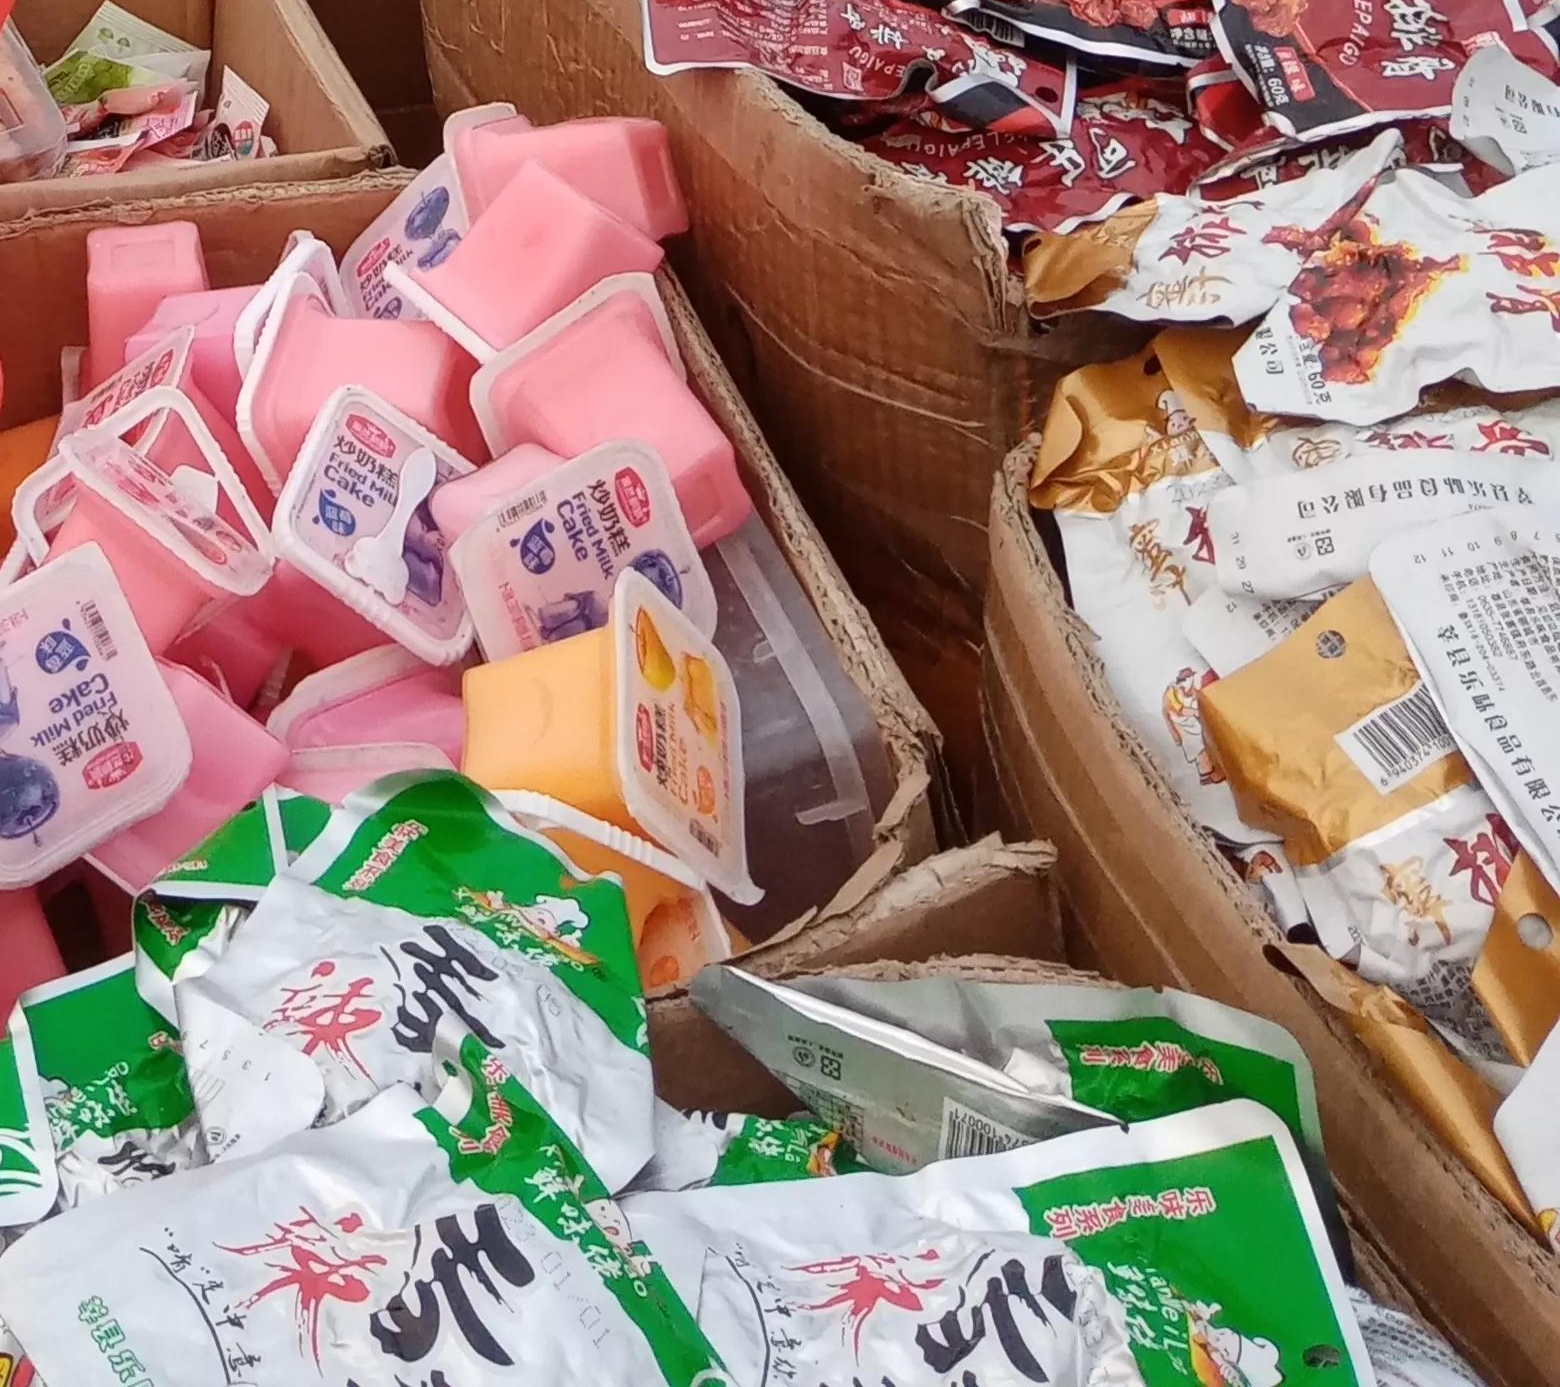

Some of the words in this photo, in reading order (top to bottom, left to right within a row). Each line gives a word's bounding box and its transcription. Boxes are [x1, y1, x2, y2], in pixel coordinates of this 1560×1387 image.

[322, 469, 376, 511] Cake
[587, 476, 632, 555] 炒奶糕
[554, 498, 589, 563] Cake
[571, 490, 604, 538] Fried
[590, 538, 616, 580] Milk
[48, 671, 114, 715] Cake
[70, 691, 120, 729] Fried
[30, 714, 71, 746] Milk
[57, 705, 132, 768] 炒奶糕
[1437, 623, 1560, 830] 莘县乐味食品有限公
[1043, 1186, 1216, 1242] 乐味美食系列
